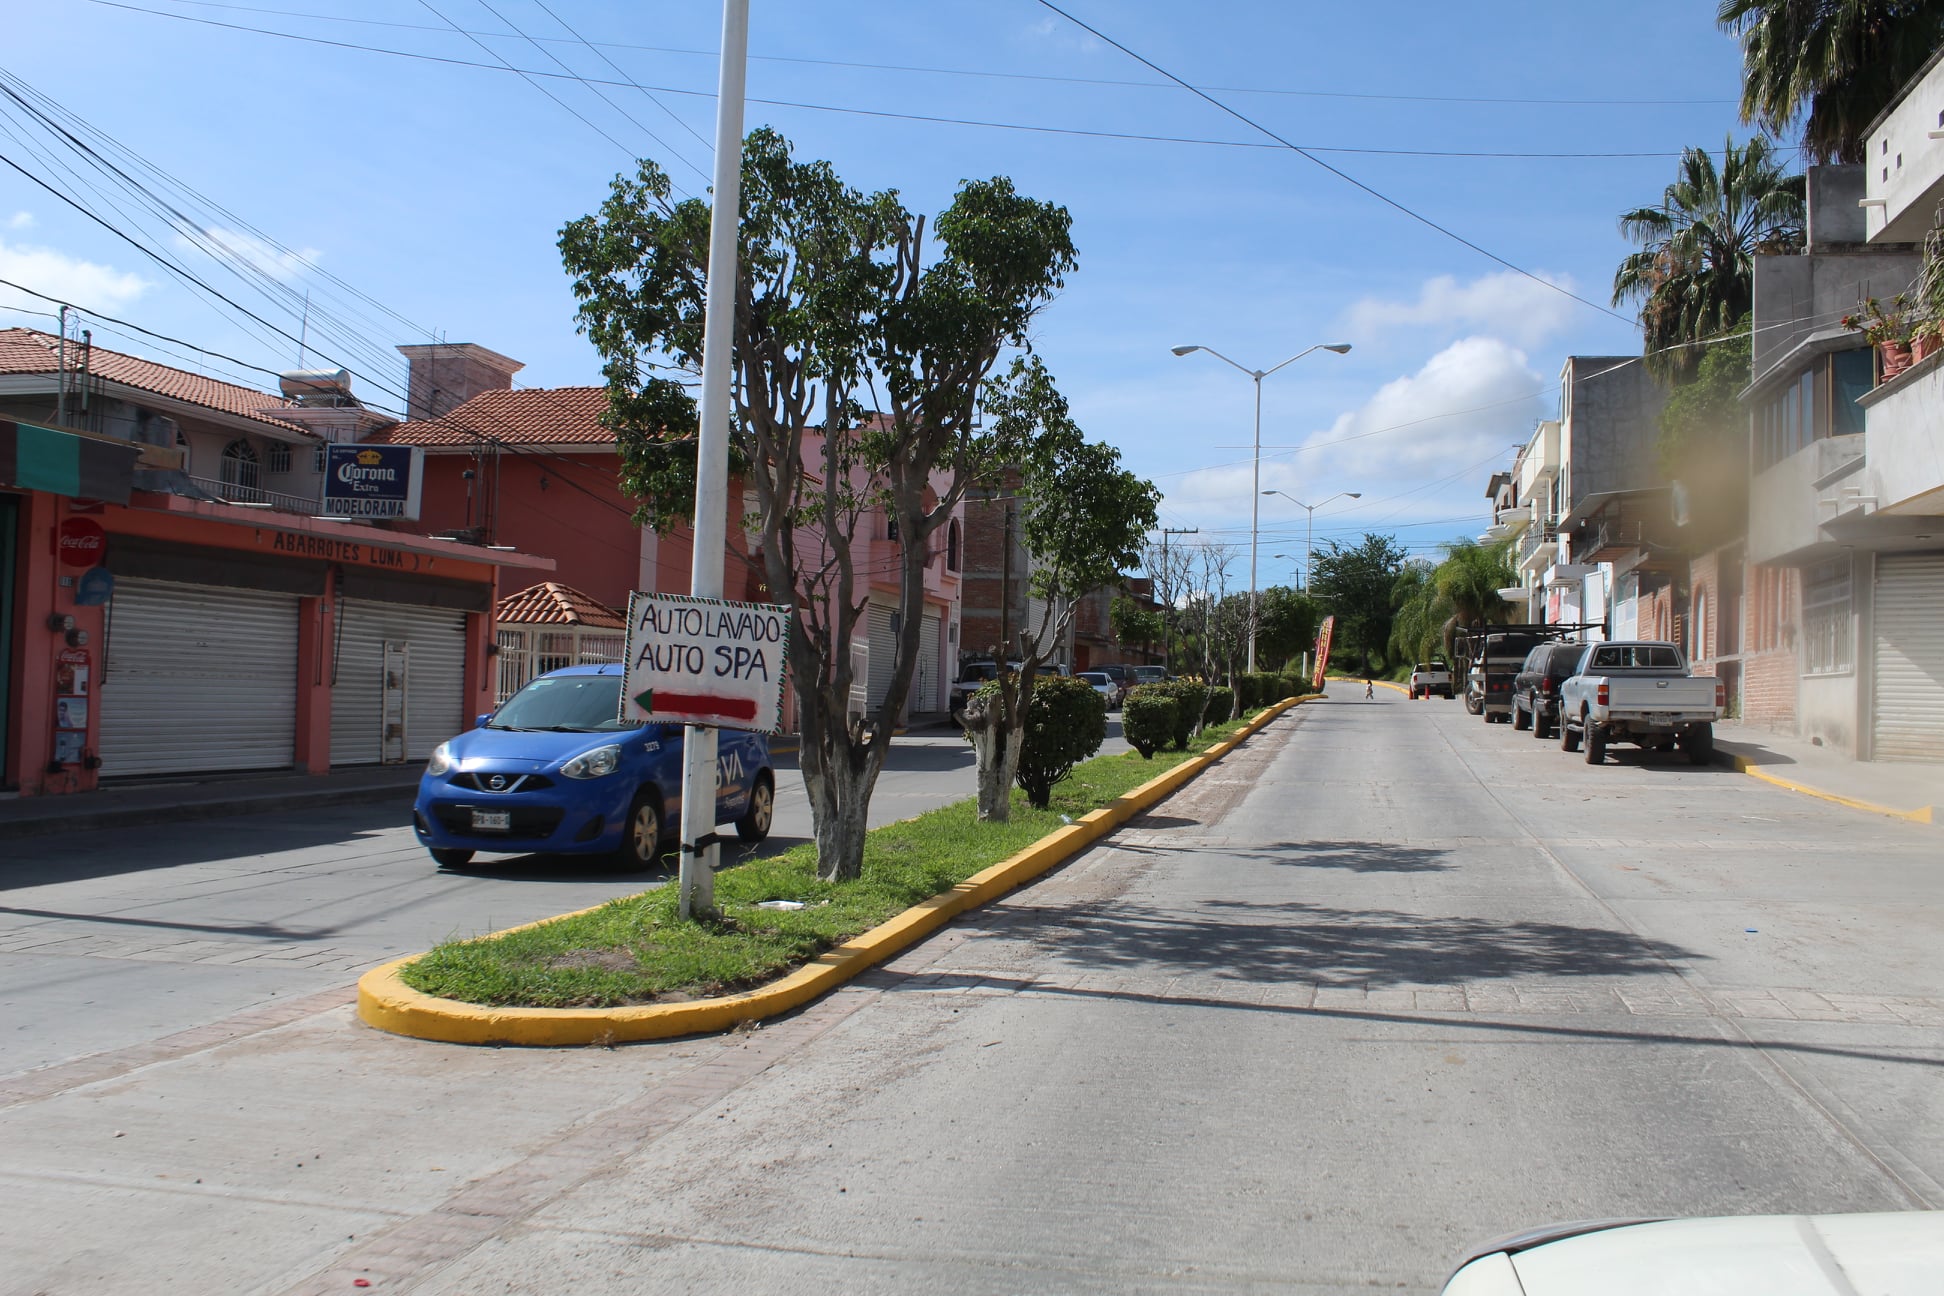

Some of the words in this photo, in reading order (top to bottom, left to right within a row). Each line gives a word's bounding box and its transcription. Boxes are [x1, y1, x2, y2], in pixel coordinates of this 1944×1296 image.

[337, 462, 397, 485] Corona
[353, 481, 379, 492] Extra
[325, 498, 405, 517] MODELORAMA
[273, 531, 360, 562] ABARROTES
[369, 546, 404, 568] LUNA
[635, 643, 704, 675] AUTO
[714, 645, 768, 683] SPA
